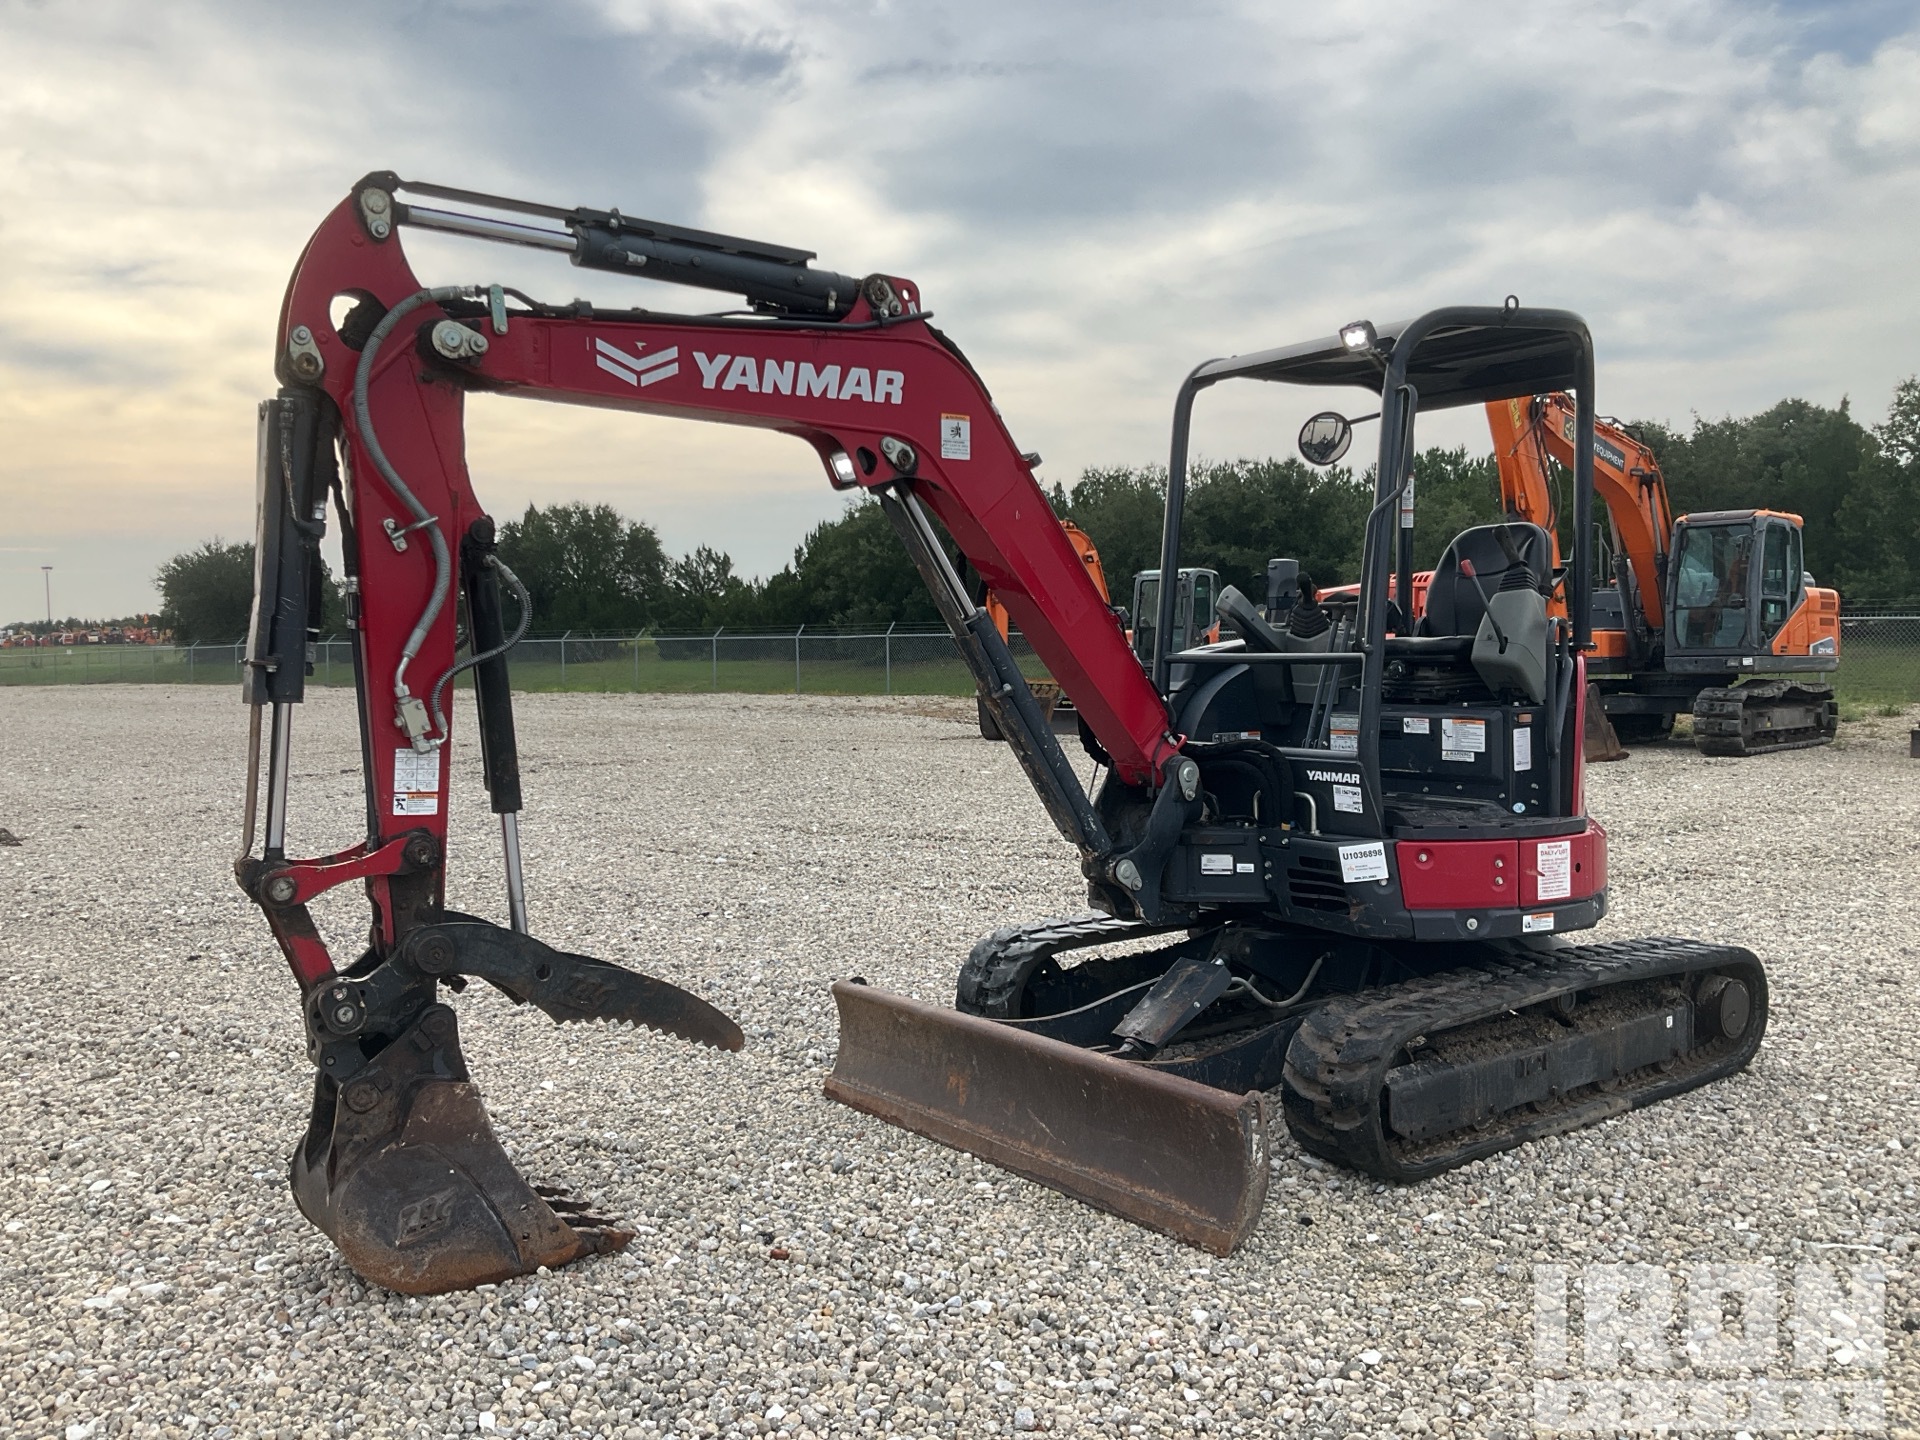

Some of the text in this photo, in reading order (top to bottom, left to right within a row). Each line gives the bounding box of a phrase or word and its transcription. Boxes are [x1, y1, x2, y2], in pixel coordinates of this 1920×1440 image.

[693, 351, 904, 404] YANMAR
[1597, 444, 1624, 469] EQUIPMENT
[1306, 770, 1360, 784] YANMAR
[1342, 849, 1383, 860] U1036898
